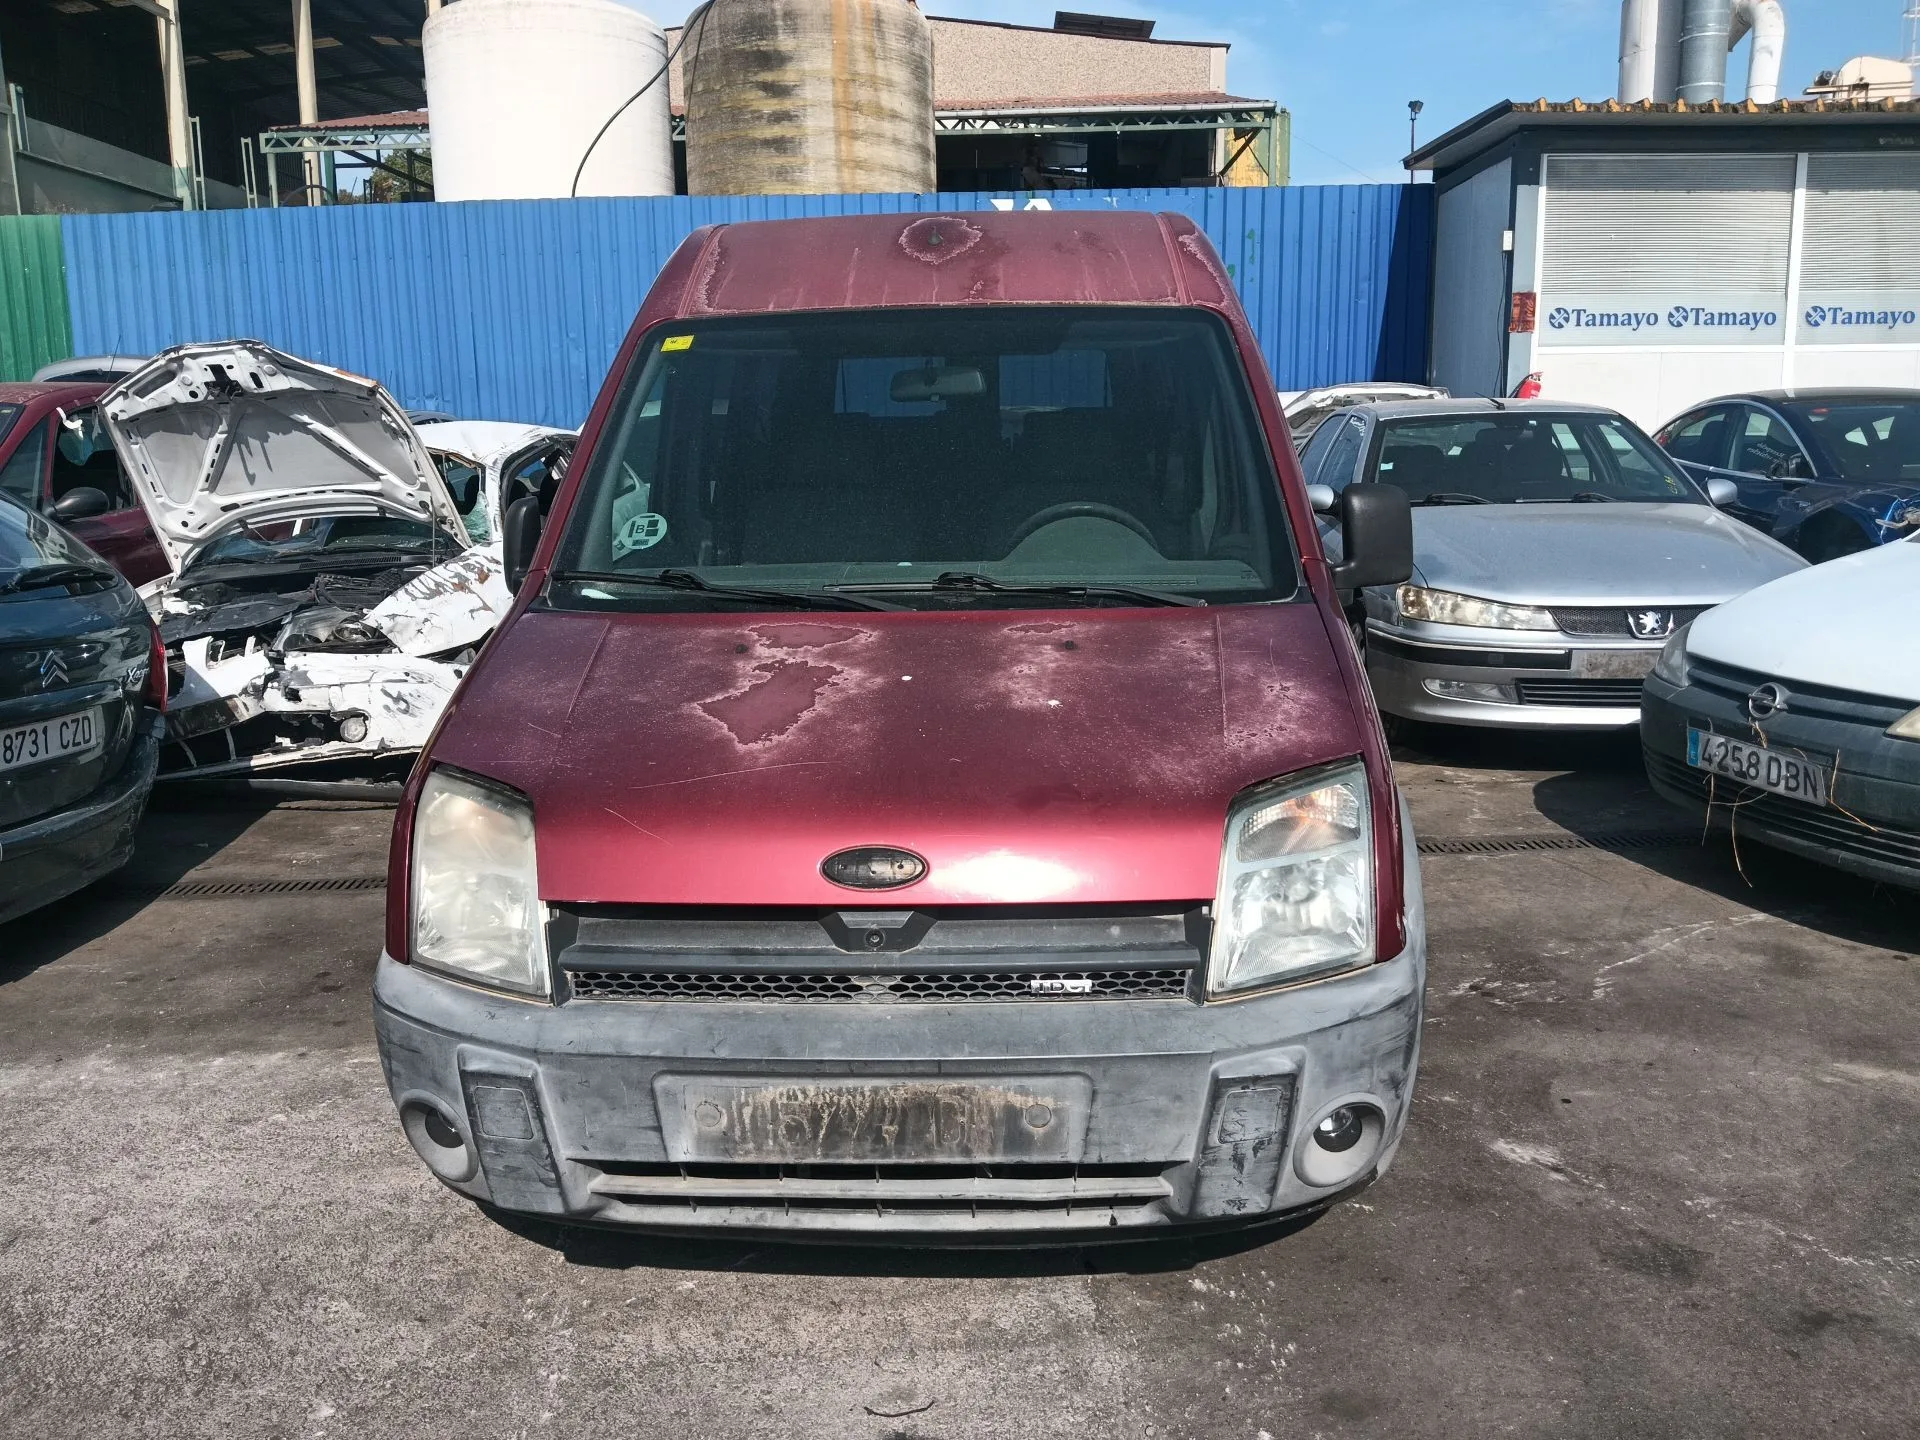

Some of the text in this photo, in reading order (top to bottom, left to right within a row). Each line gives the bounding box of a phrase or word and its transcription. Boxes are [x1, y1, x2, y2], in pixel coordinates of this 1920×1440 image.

[1571, 308, 1777, 330] Tamayo Tamayo
[1827, 307, 1916, 329] Tamayo
[635, 524, 645, 534] B
[3, 715, 92, 764] 8731 CZD
[1702, 738, 1818, 799] 4258 DBN
